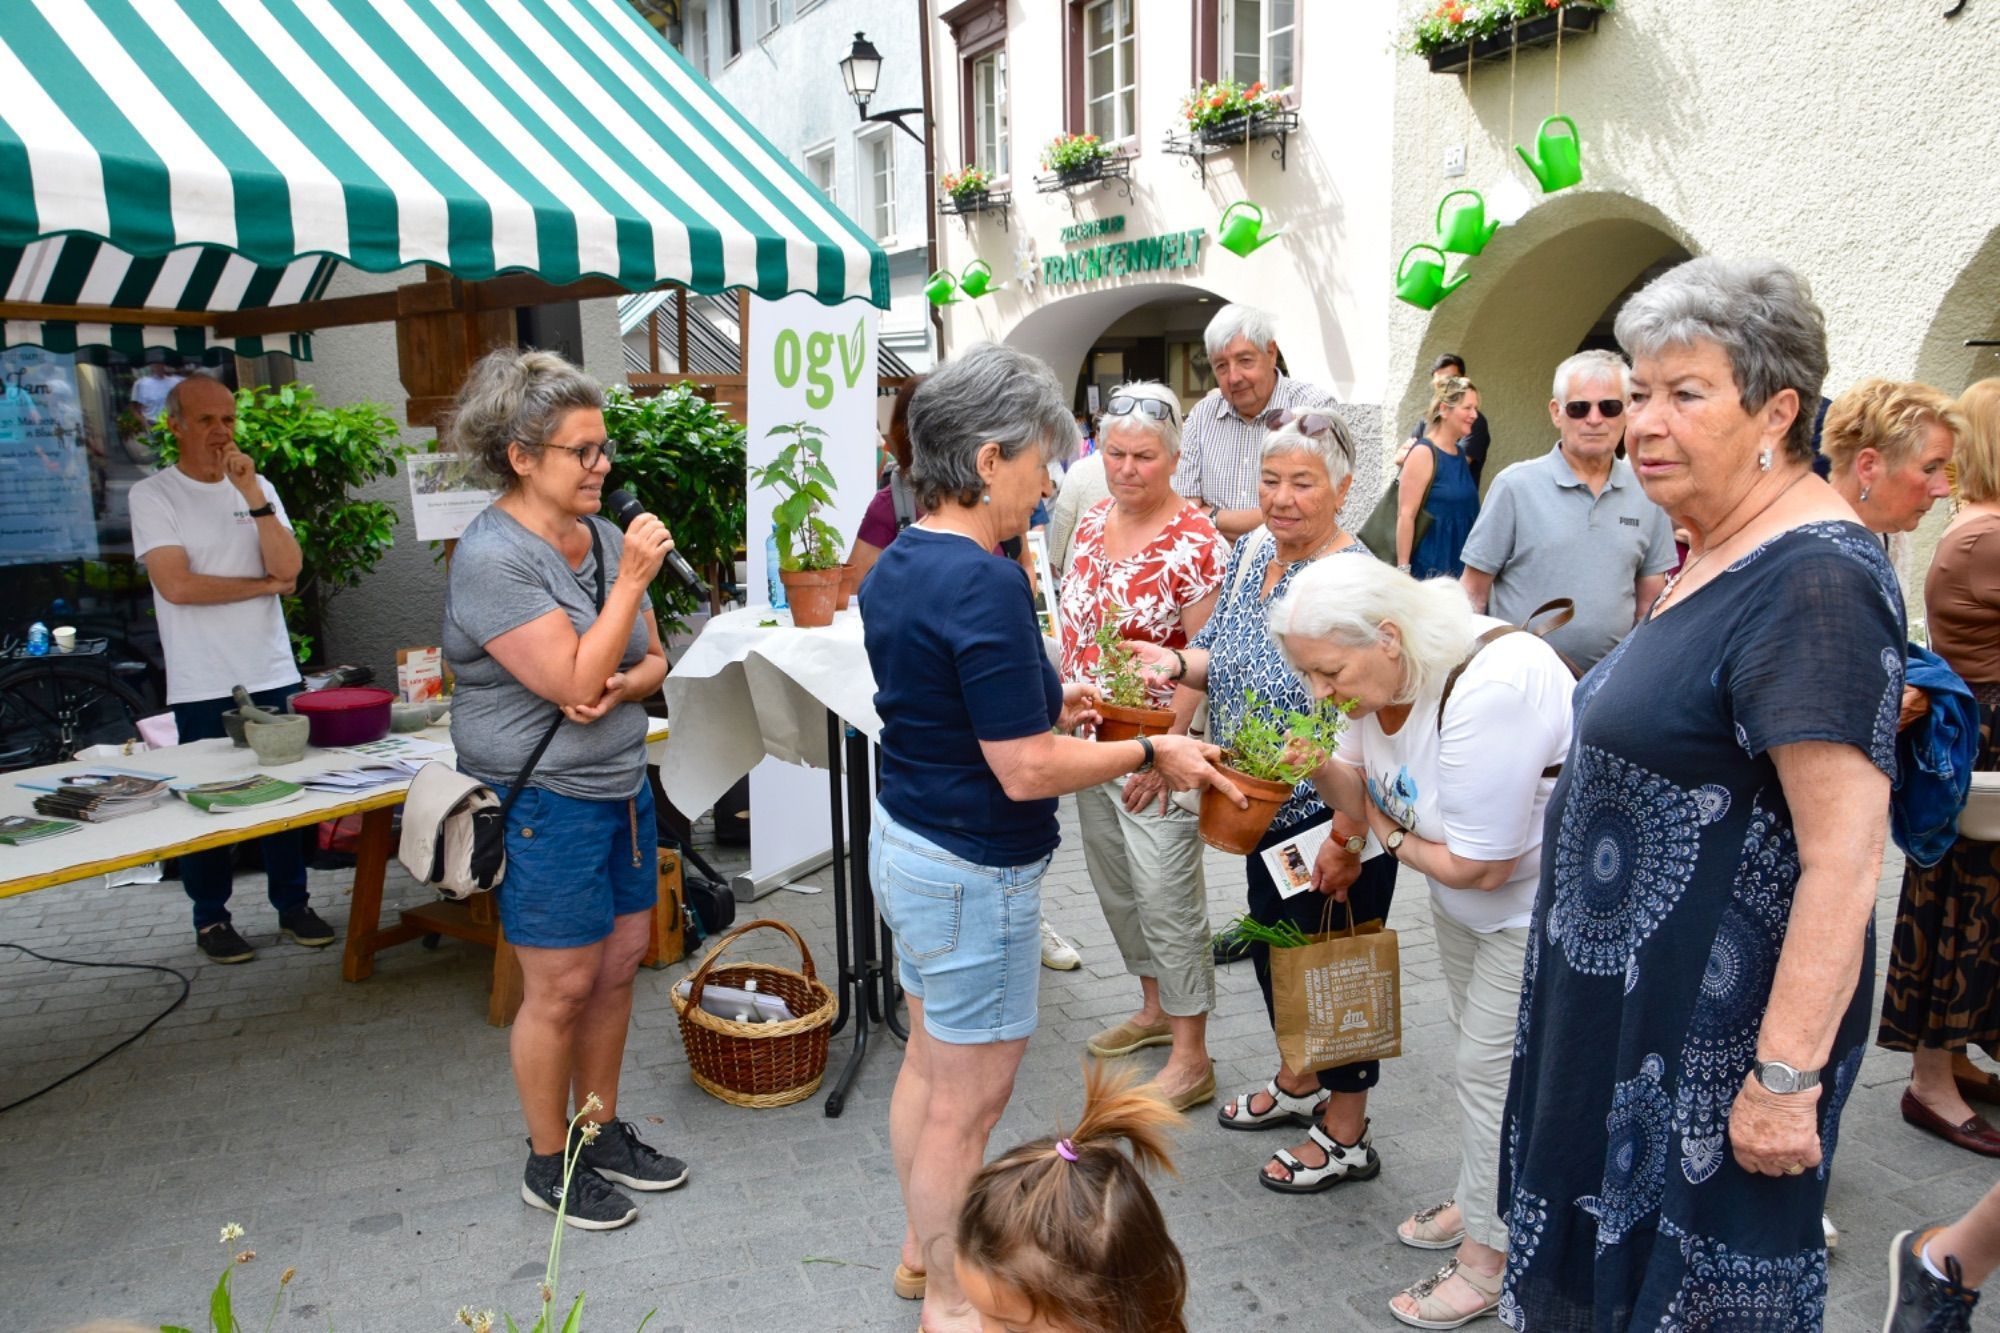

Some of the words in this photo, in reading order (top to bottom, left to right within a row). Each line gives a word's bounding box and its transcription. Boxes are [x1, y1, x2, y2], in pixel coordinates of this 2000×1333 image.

[1041, 228, 1206, 286] TRACHTENWELT
[774, 315, 865, 410] ogv
[1343, 1009, 1364, 1025] dm
